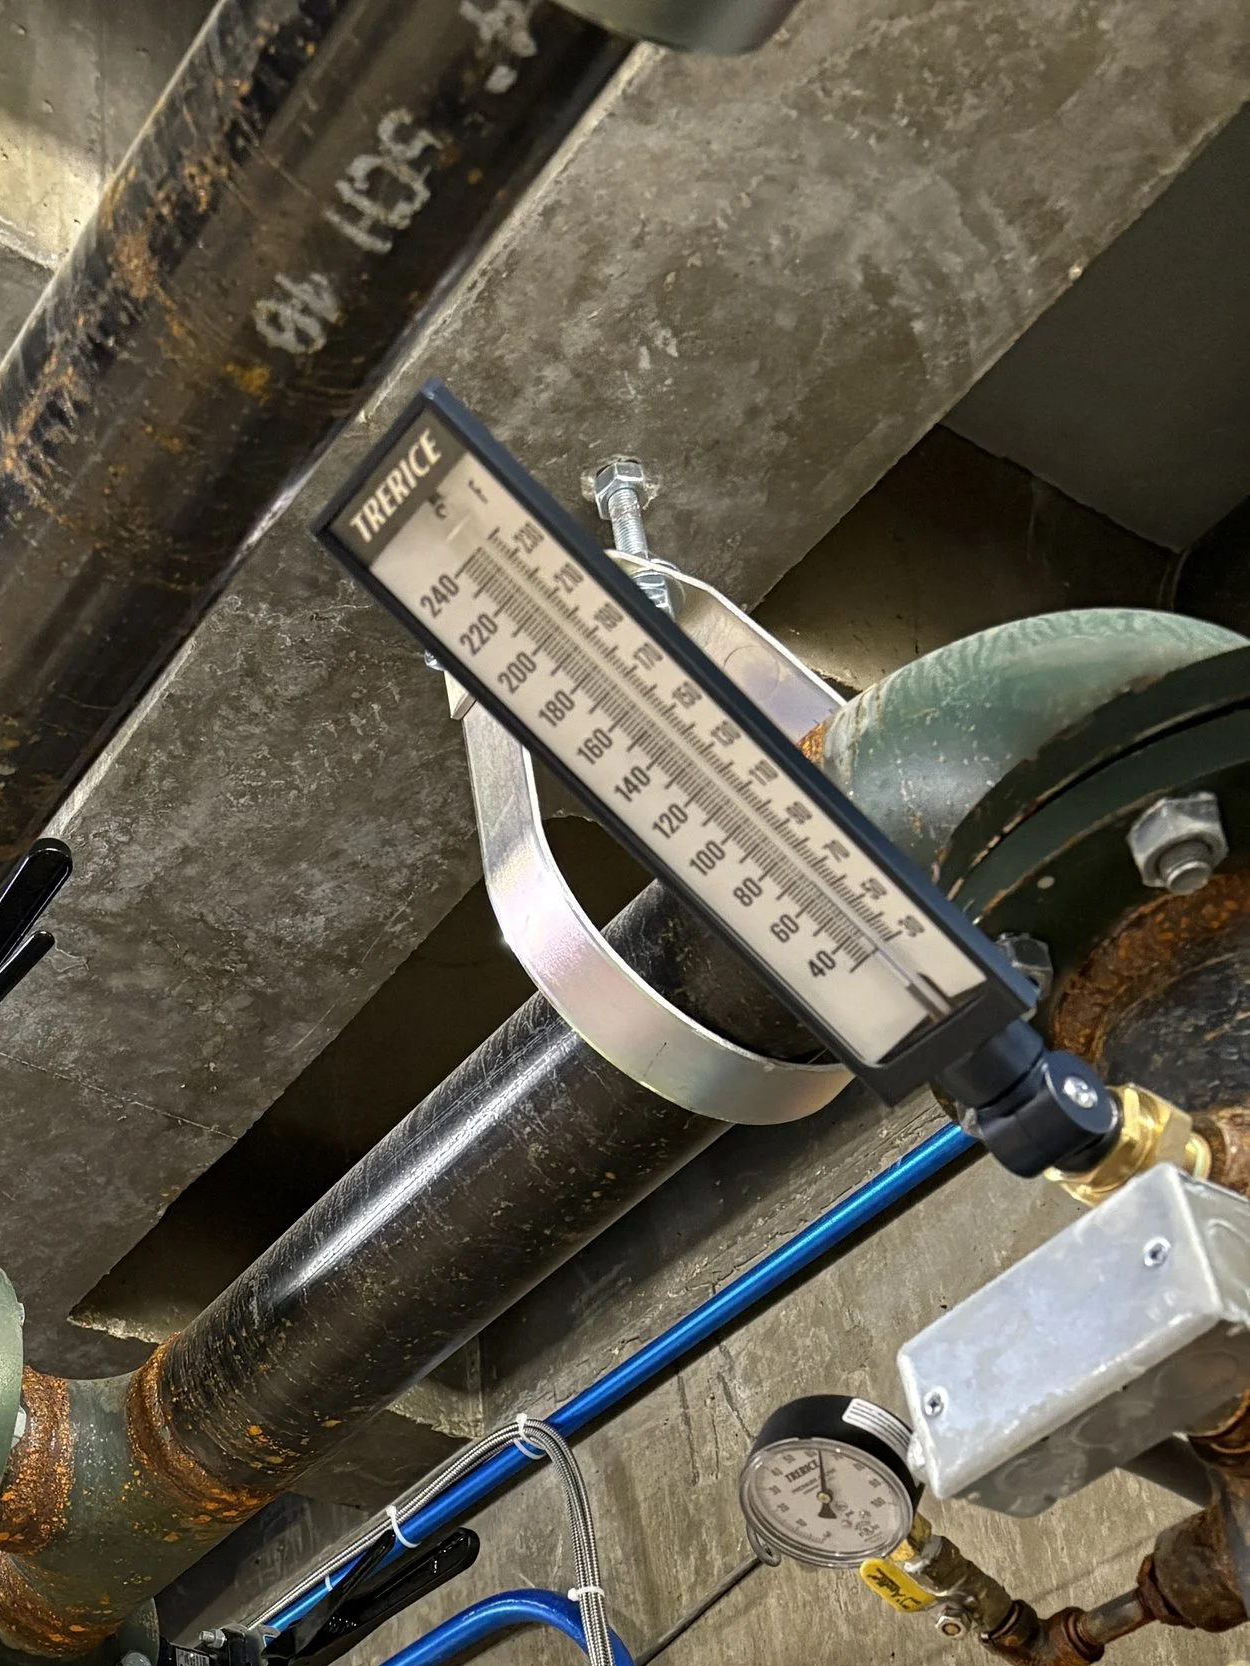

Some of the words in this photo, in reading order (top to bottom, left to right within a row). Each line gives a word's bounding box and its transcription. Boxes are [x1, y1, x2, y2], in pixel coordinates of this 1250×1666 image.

[349, 428, 442, 543] TRERICE
[420, 576, 459, 618] 240
[460, 614, 498, 656] 220
[499, 654, 537, 695] 200
[539, 690, 575, 730] 180
[577, 728, 613, 766] 160
[615, 768, 652, 802] 140
[653, 804, 688, 840] 120
[690, 840, 726, 876] 100
[734, 877, 763, 907] 80
[771, 914, 799, 943] 60
[808, 951, 837, 978] 40
[785, 1459, 820, 1482] TRERICE
